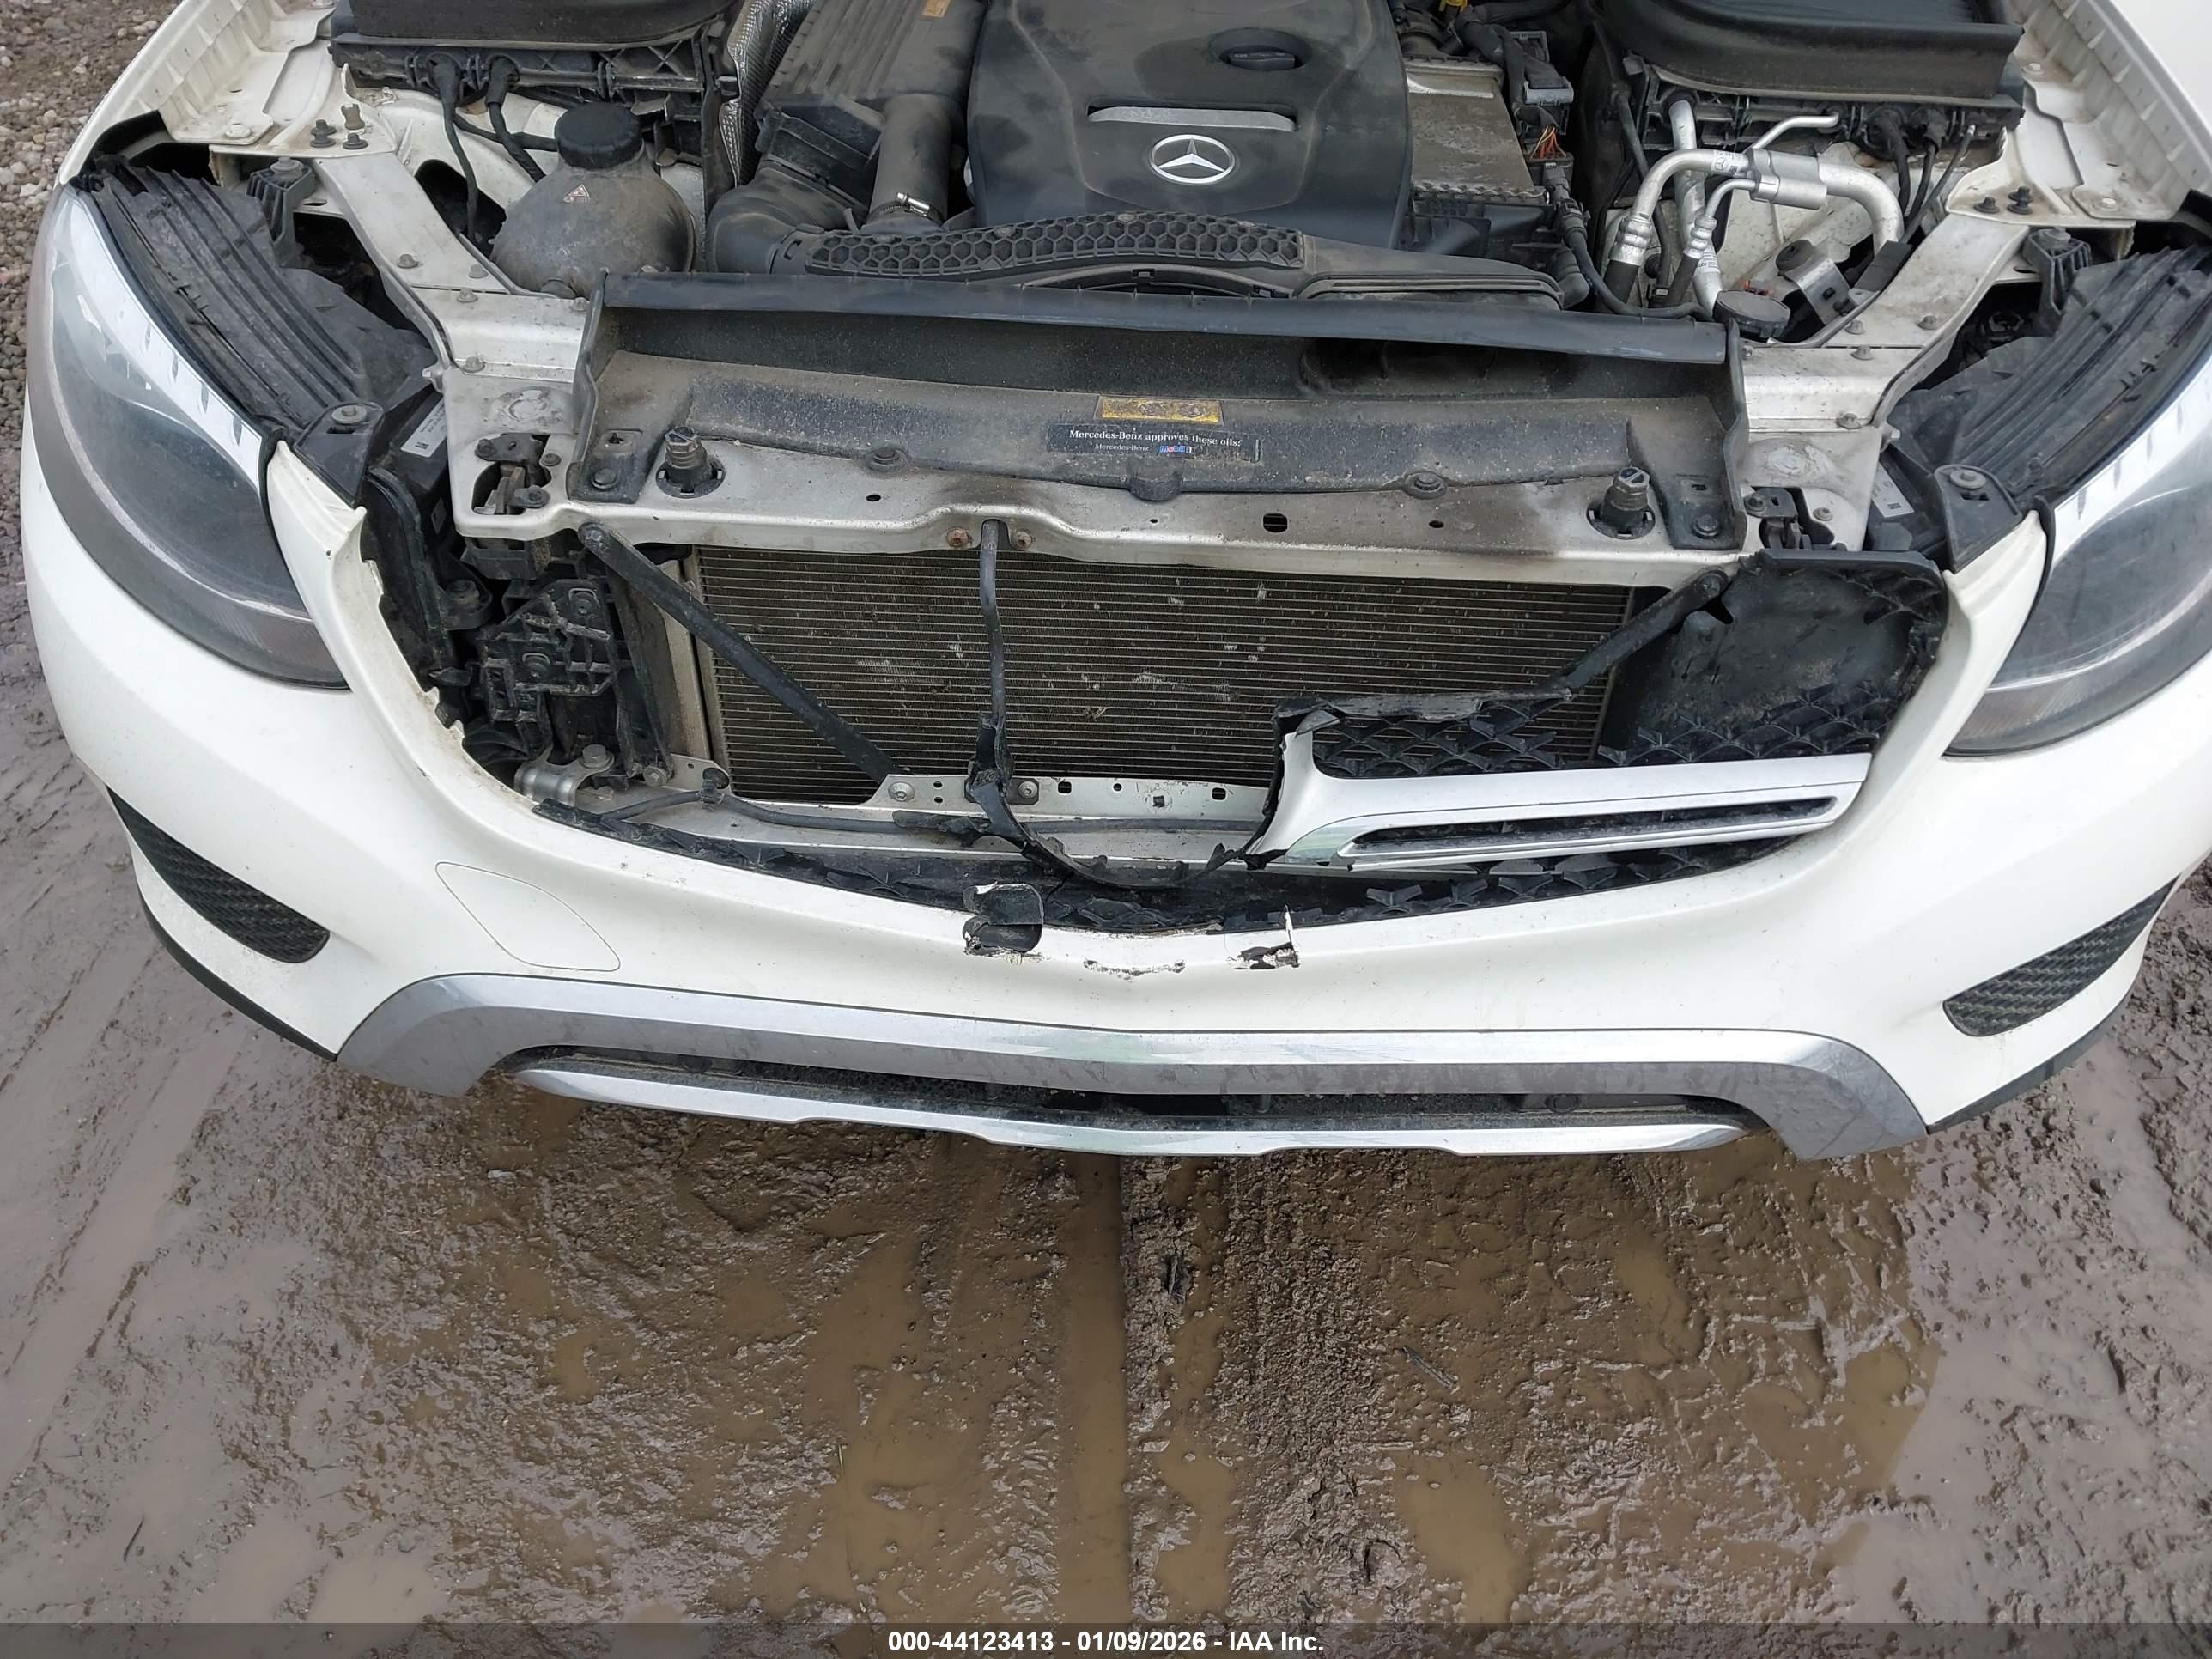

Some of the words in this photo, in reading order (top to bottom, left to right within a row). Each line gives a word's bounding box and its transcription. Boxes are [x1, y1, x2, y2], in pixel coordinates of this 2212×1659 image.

[1069, 429, 1143, 441] Mercedes-Benz
[1145, 433, 1189, 443] approves
[1191, 434, 1218, 445] these
[1094, 443, 1150, 452] Mercedes-Benz
